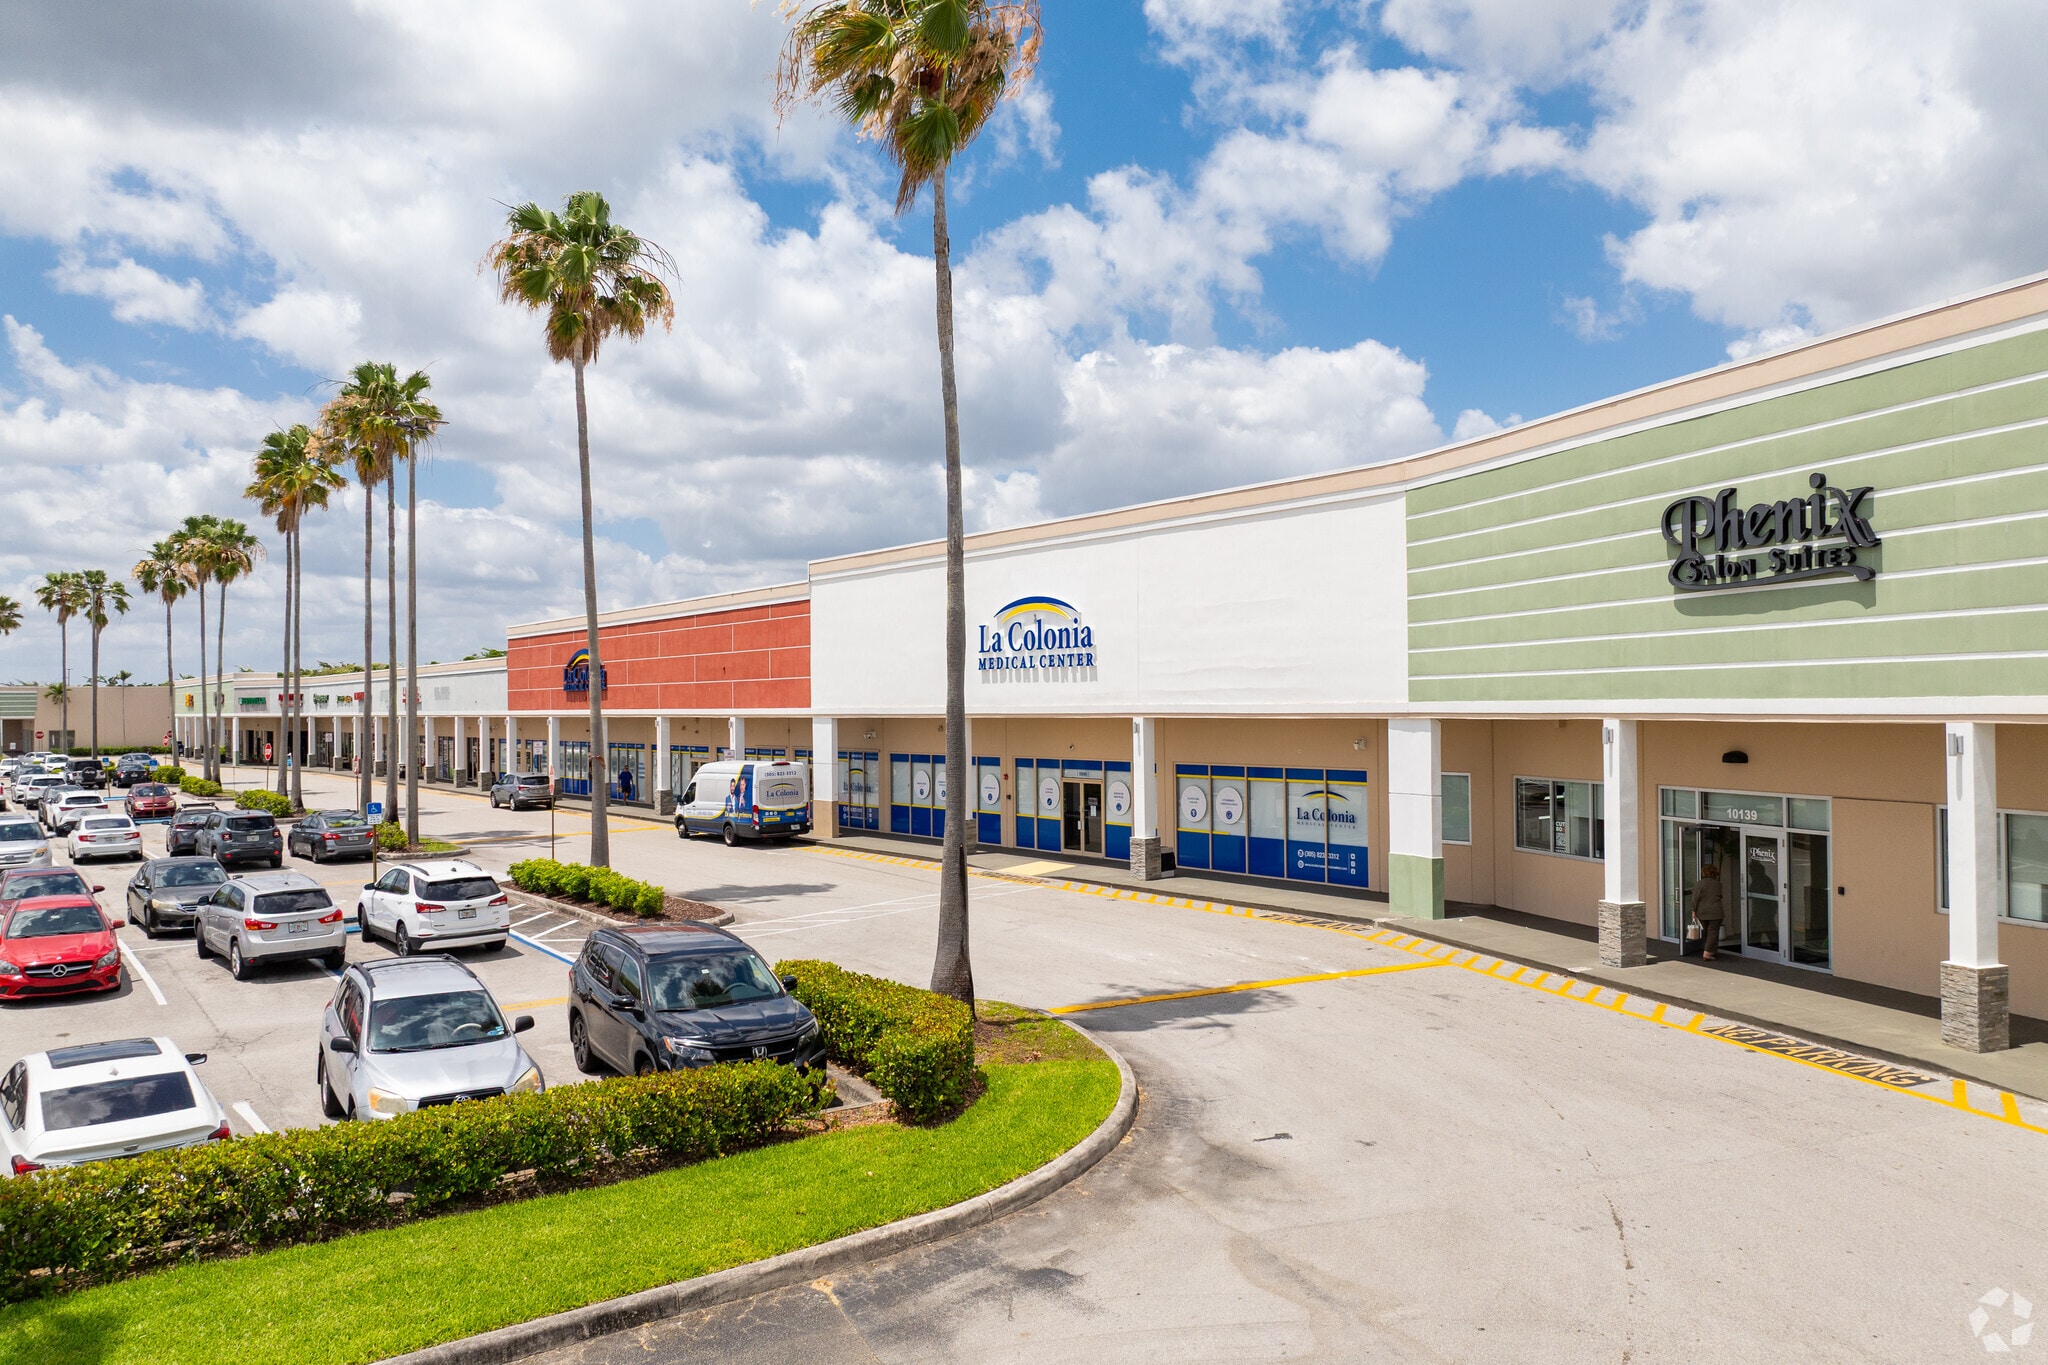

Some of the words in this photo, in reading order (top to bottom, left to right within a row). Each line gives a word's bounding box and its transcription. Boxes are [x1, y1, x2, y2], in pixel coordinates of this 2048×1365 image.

[1661, 473, 1882, 552] Phenix
[978, 625, 1003, 653] La
[1008, 617, 1094, 652] Colonia
[978, 656, 1036, 670] MEDICAL
[1039, 652, 1095, 668] CENTER
[775, 788, 799, 797] Colonia
[1297, 807, 1309, 820] La
[1726, 808, 1758, 820] 10139
[1750, 847, 1776, 861] Phenix
[1702, 1024, 1766, 1040] NO
[1746, 1037, 1931, 1085] PARKING
